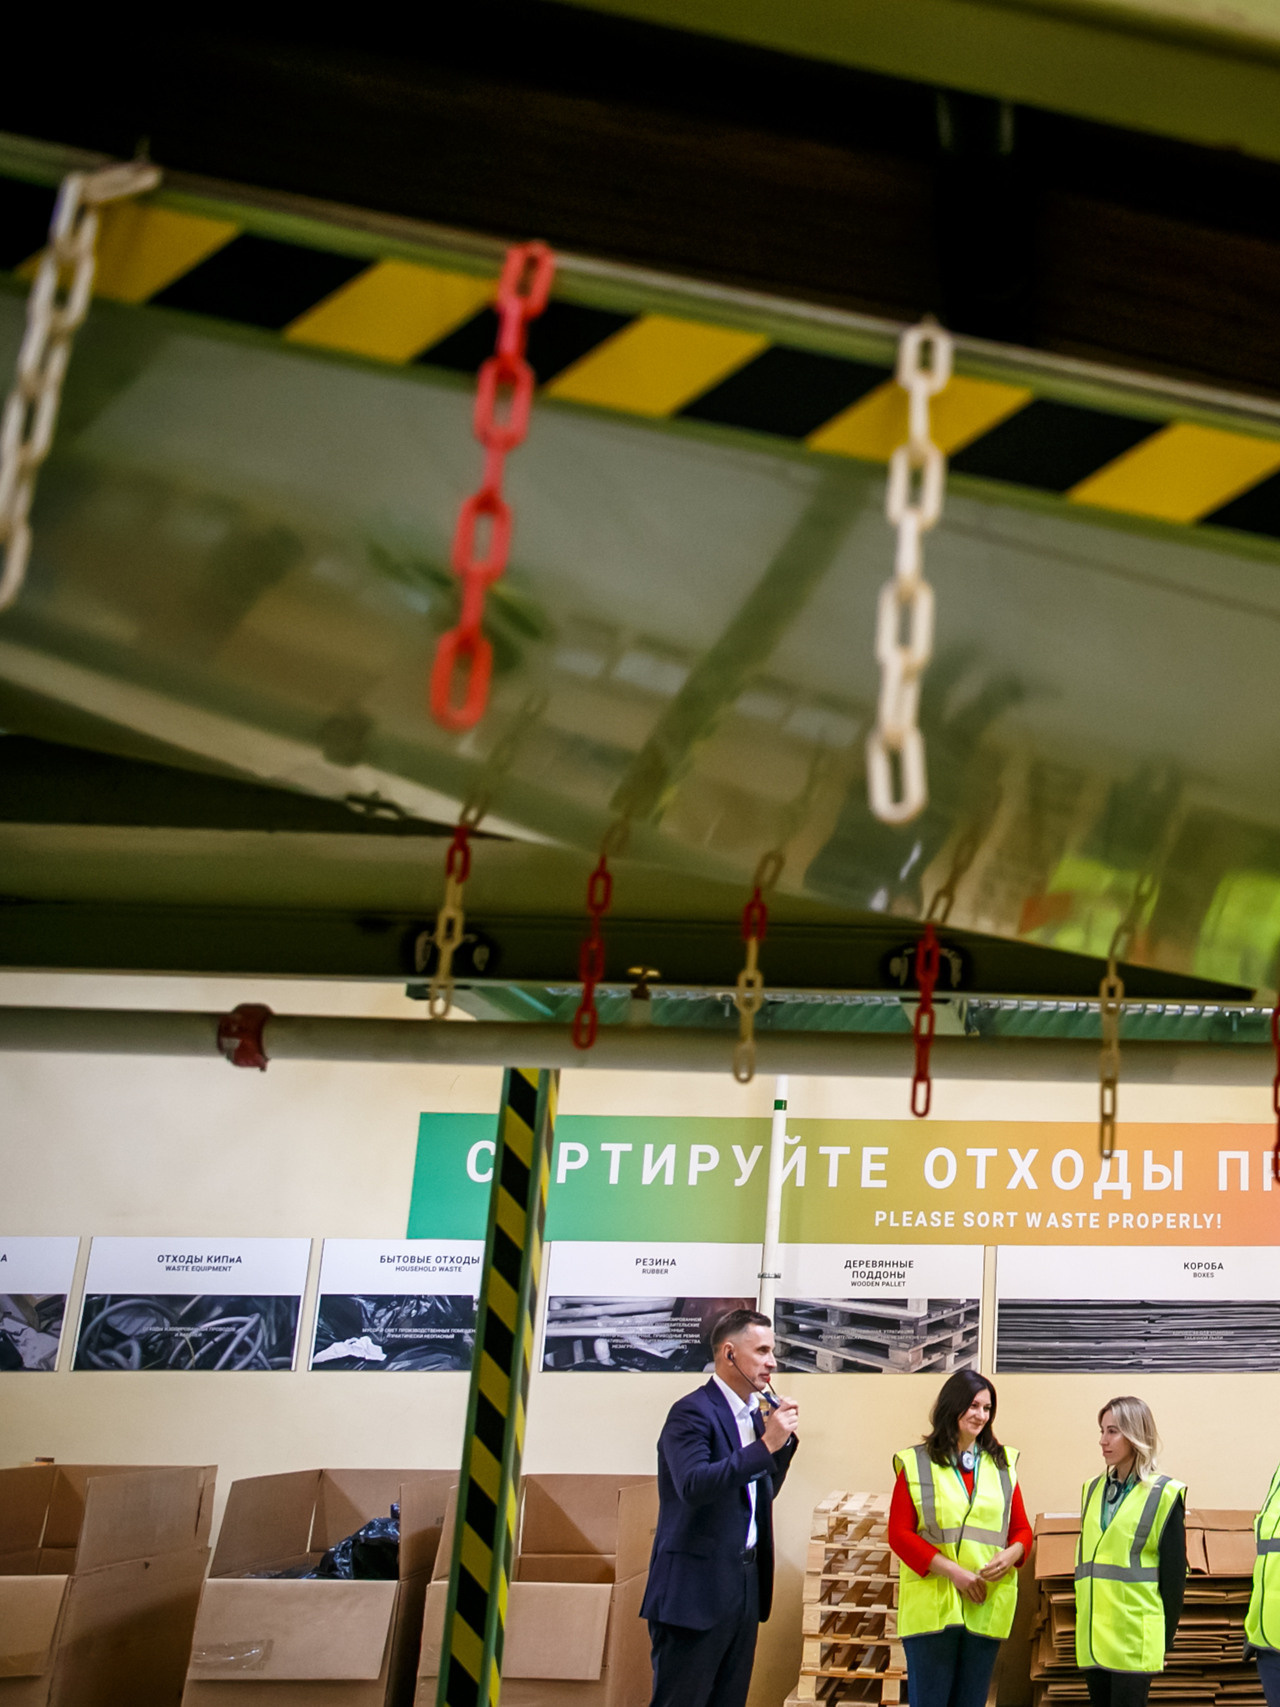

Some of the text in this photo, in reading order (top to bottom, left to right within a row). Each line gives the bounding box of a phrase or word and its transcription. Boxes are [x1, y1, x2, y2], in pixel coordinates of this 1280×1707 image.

[466, 1135, 889, 1188] СРТИРУЙТЕ
[924, 1147, 1183, 1200] ОТХОДЫ
[874, 1210, 1223, 1230] PLEASE SORT WASTE PROPERLY!
[157, 1254, 243, 1265] ОТХОДЫ КИПиА
[379, 1255, 481, 1266] БЫТОВЫЕ ОТХОДЫ
[635, 1258, 677, 1267] РЕЗИНА
[191, 1265, 232, 1273] EQUIPMENT
[843, 1260, 915, 1270] ДЕРЕВЯННЫЕ
[1183, 1262, 1225, 1270] КОРОБА
[851, 1270, 906, 1280] ПОДДОНЫ
